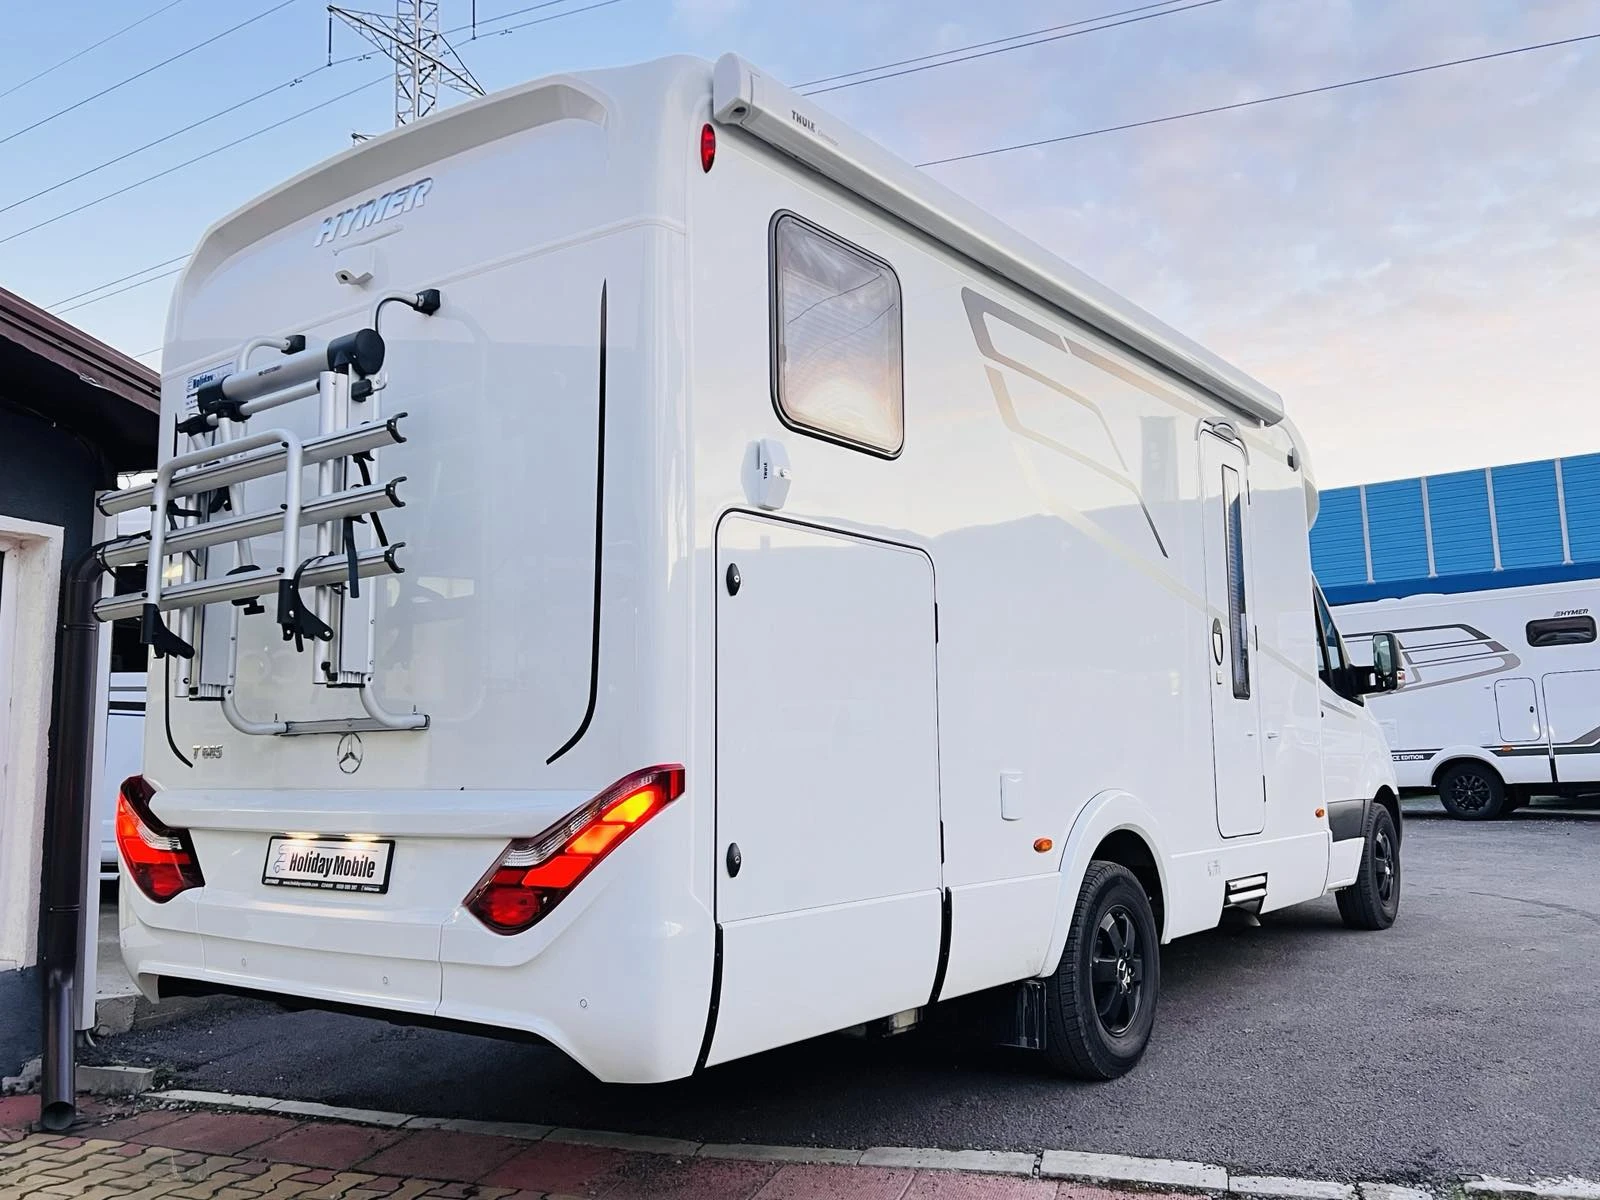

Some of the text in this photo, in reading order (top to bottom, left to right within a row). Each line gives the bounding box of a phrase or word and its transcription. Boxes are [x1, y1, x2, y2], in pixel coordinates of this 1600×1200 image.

[791, 109, 816, 133] THULE
[313, 177, 434, 248] HYMER
[1560, 608, 1589, 617] HYMER
[192, 744, 201, 760] T
[289, 850, 376, 879] Holiday Mobile
